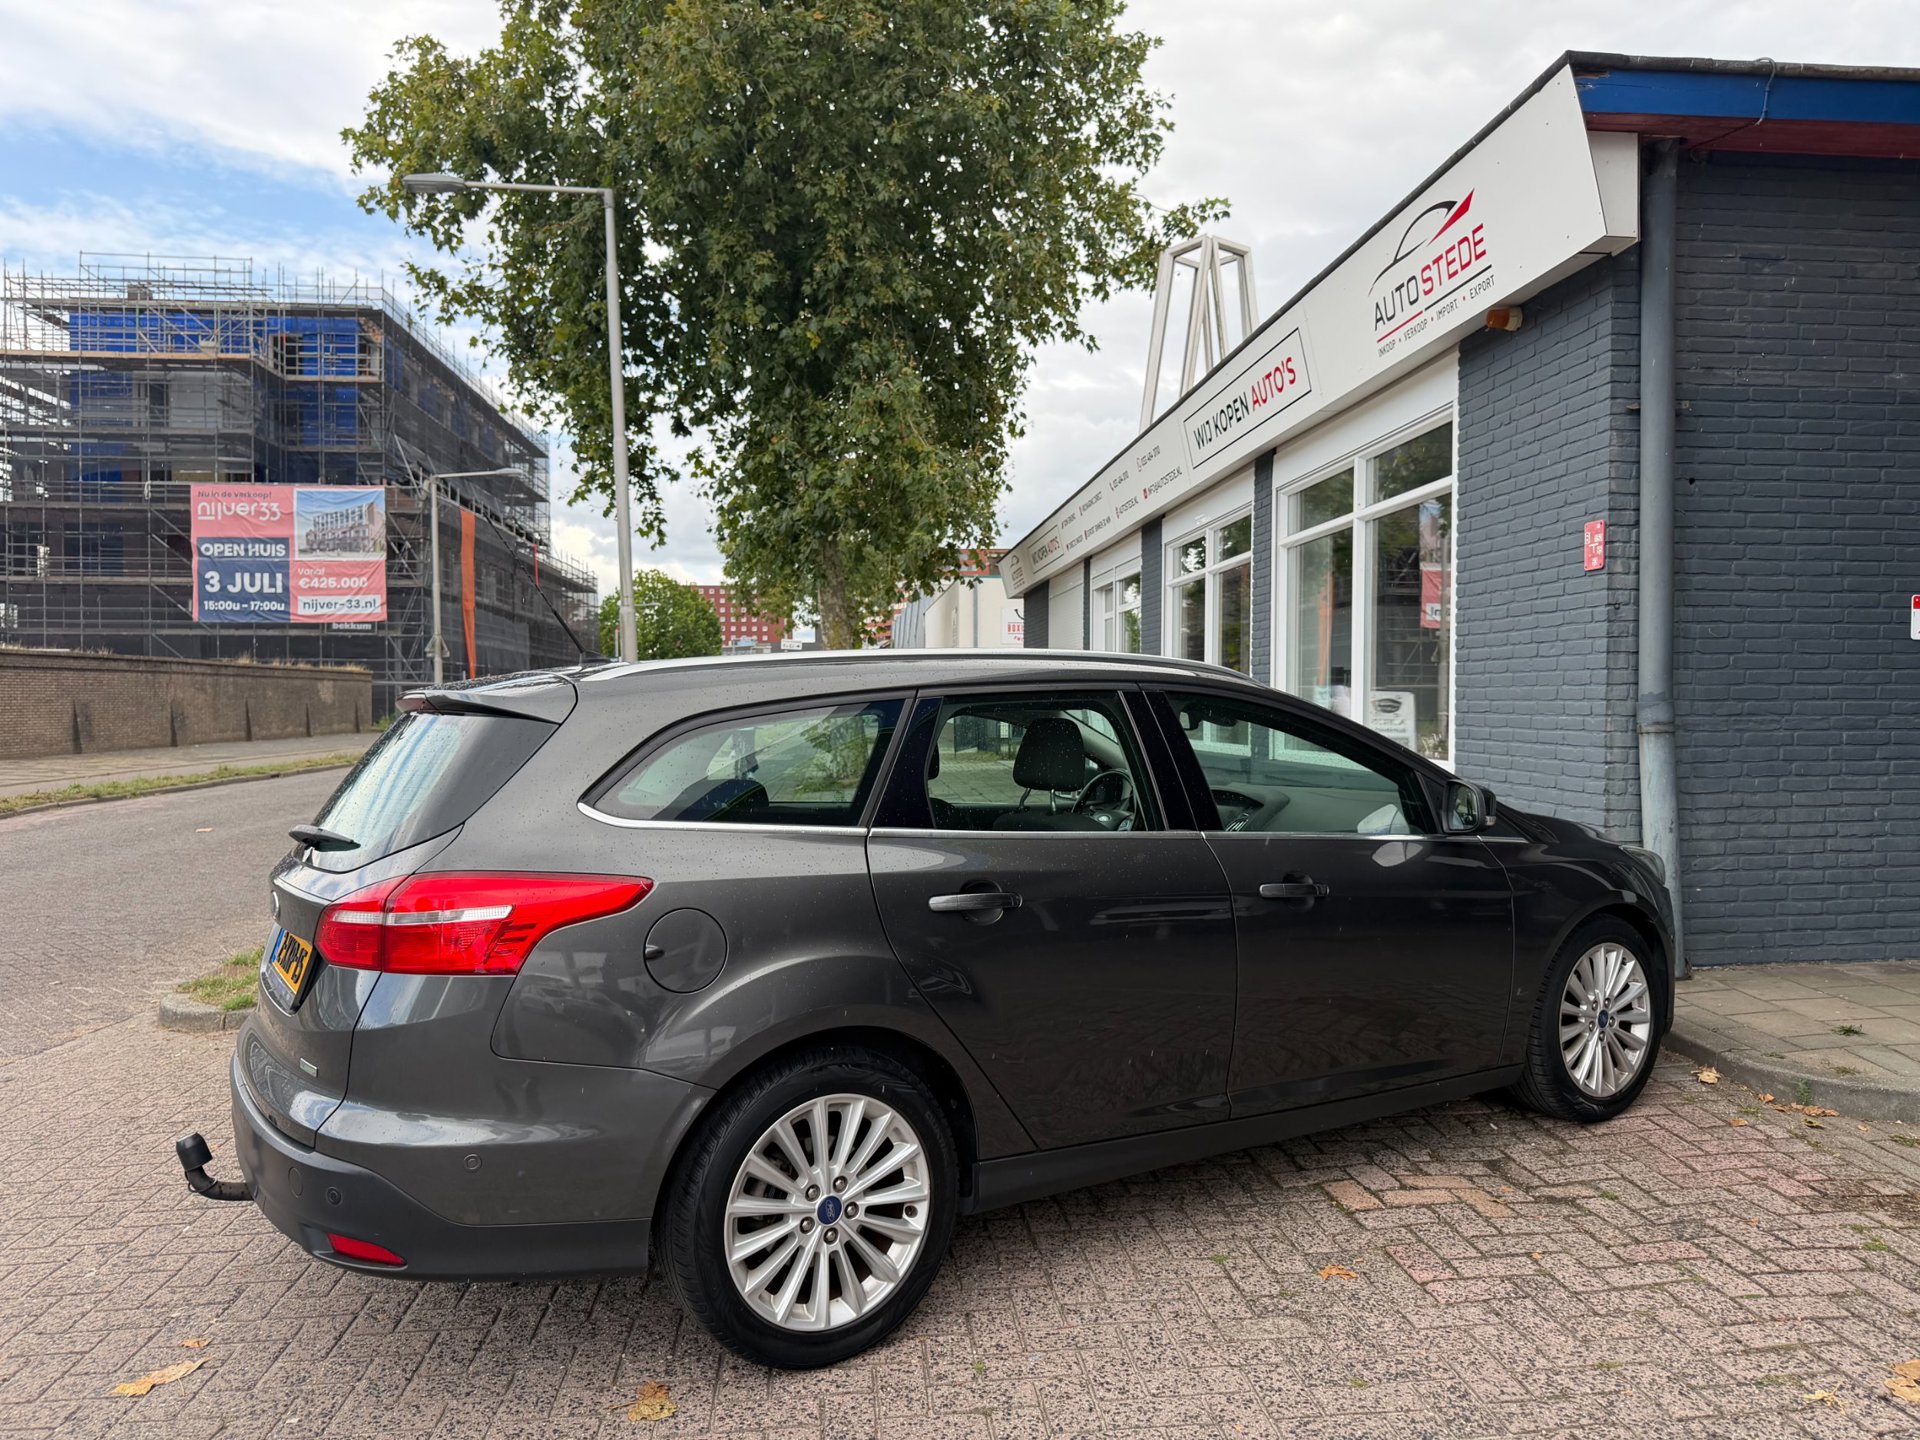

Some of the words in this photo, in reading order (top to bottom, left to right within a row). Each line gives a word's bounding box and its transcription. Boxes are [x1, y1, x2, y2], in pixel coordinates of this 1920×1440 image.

[1378, 340, 1396, 358] INKOOP
[1403, 318, 1428, 342] VERKOOP
[1435, 299, 1459, 321] IMPORT
[1469, 275, 1495, 299] EXPORT
[1193, 420, 1213, 450] WIJ
[1212, 392, 1250, 438] KOPEN
[1251, 356, 1297, 412] AUTO'S
[234, 491, 272, 500] verkoop!
[200, 543, 245, 557] OPEN
[247, 543, 286, 557] HUIS
[297, 567, 325, 576] Vanaf
[204, 570, 221, 593] 3
[226, 572, 283, 594] JULI
[298, 577, 368, 589] €425.000
[203, 600, 240, 611] 15:00u
[250, 600, 285, 611] 17:00u
[303, 597, 377, 612] nijver-33.nl
